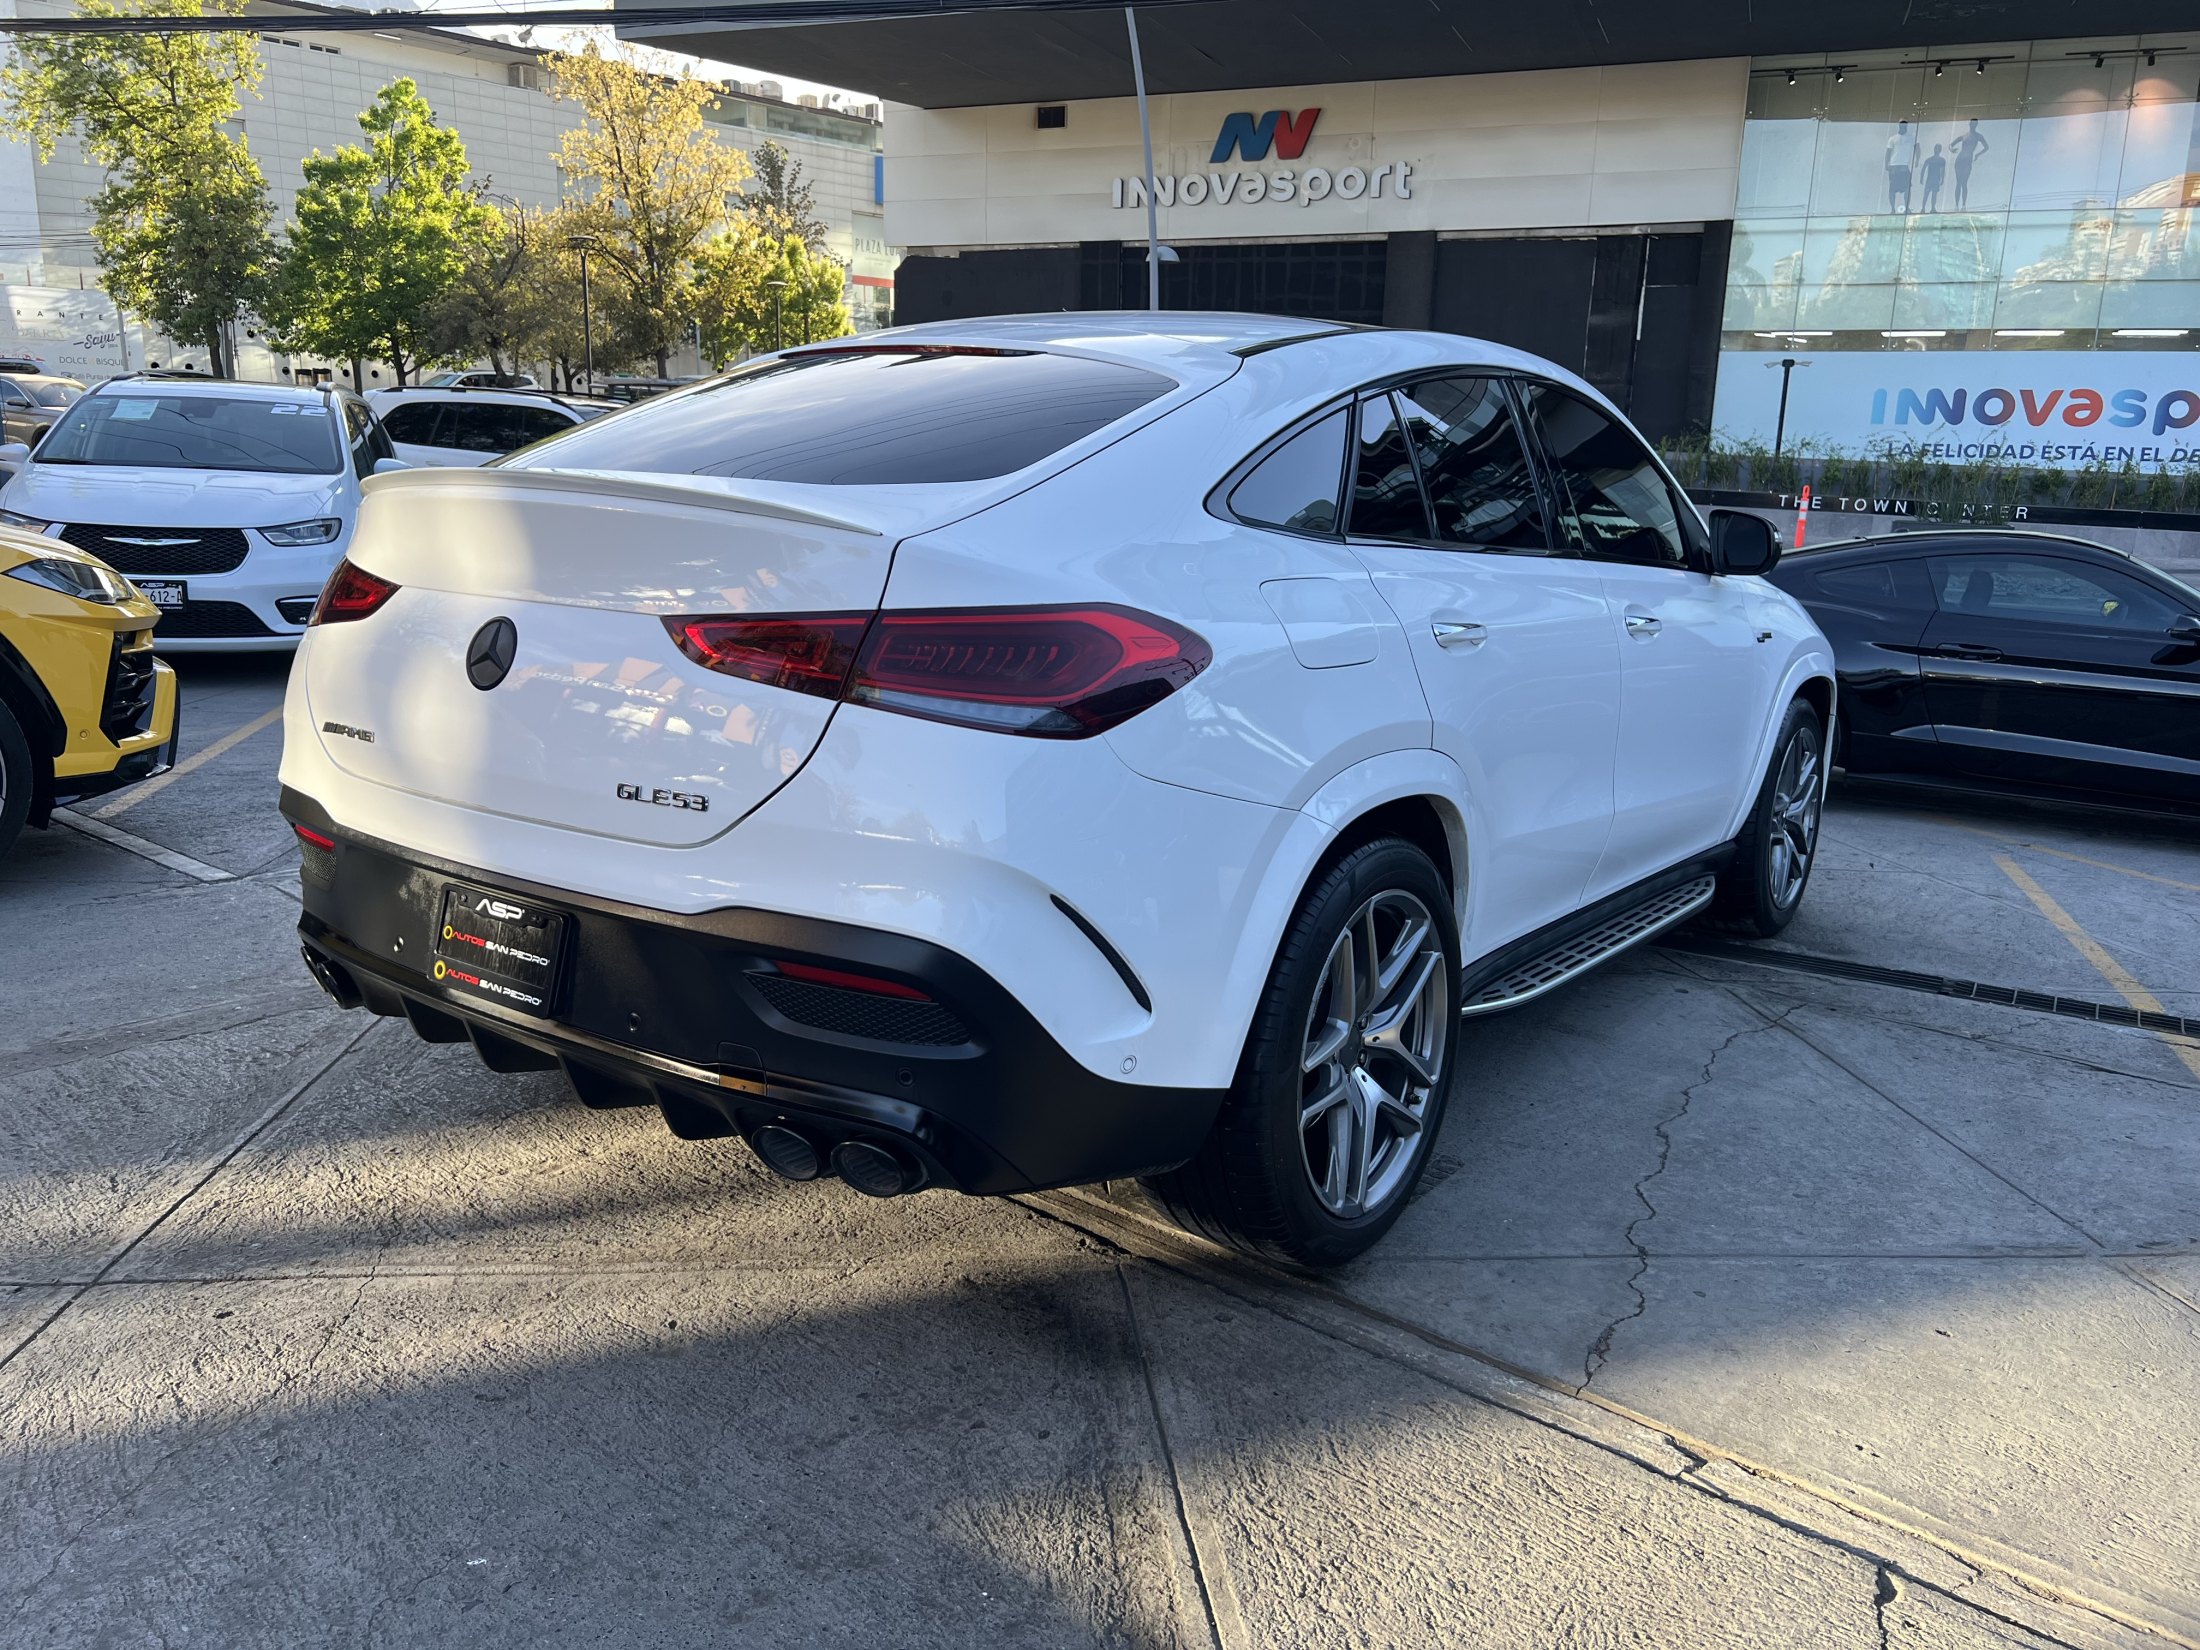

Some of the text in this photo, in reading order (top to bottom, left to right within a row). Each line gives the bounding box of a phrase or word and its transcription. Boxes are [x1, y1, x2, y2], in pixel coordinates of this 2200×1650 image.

[855, 238, 881, 254] PLAZA
[59, 356, 88, 365] DOLCE
[1920, 443, 2035, 460] FELICIDAD
[2041, 441, 2098, 461] ESTÁ
[2104, 446, 2135, 461] EN
[2140, 447, 2165, 462] EL
[1839, 497, 1907, 515] TOWN
[475, 898, 523, 920] ASP
[452, 931, 549, 966] AUTOS SAN PEDRO
[446, 968, 541, 1006] AUTOS SAN PEDRO
